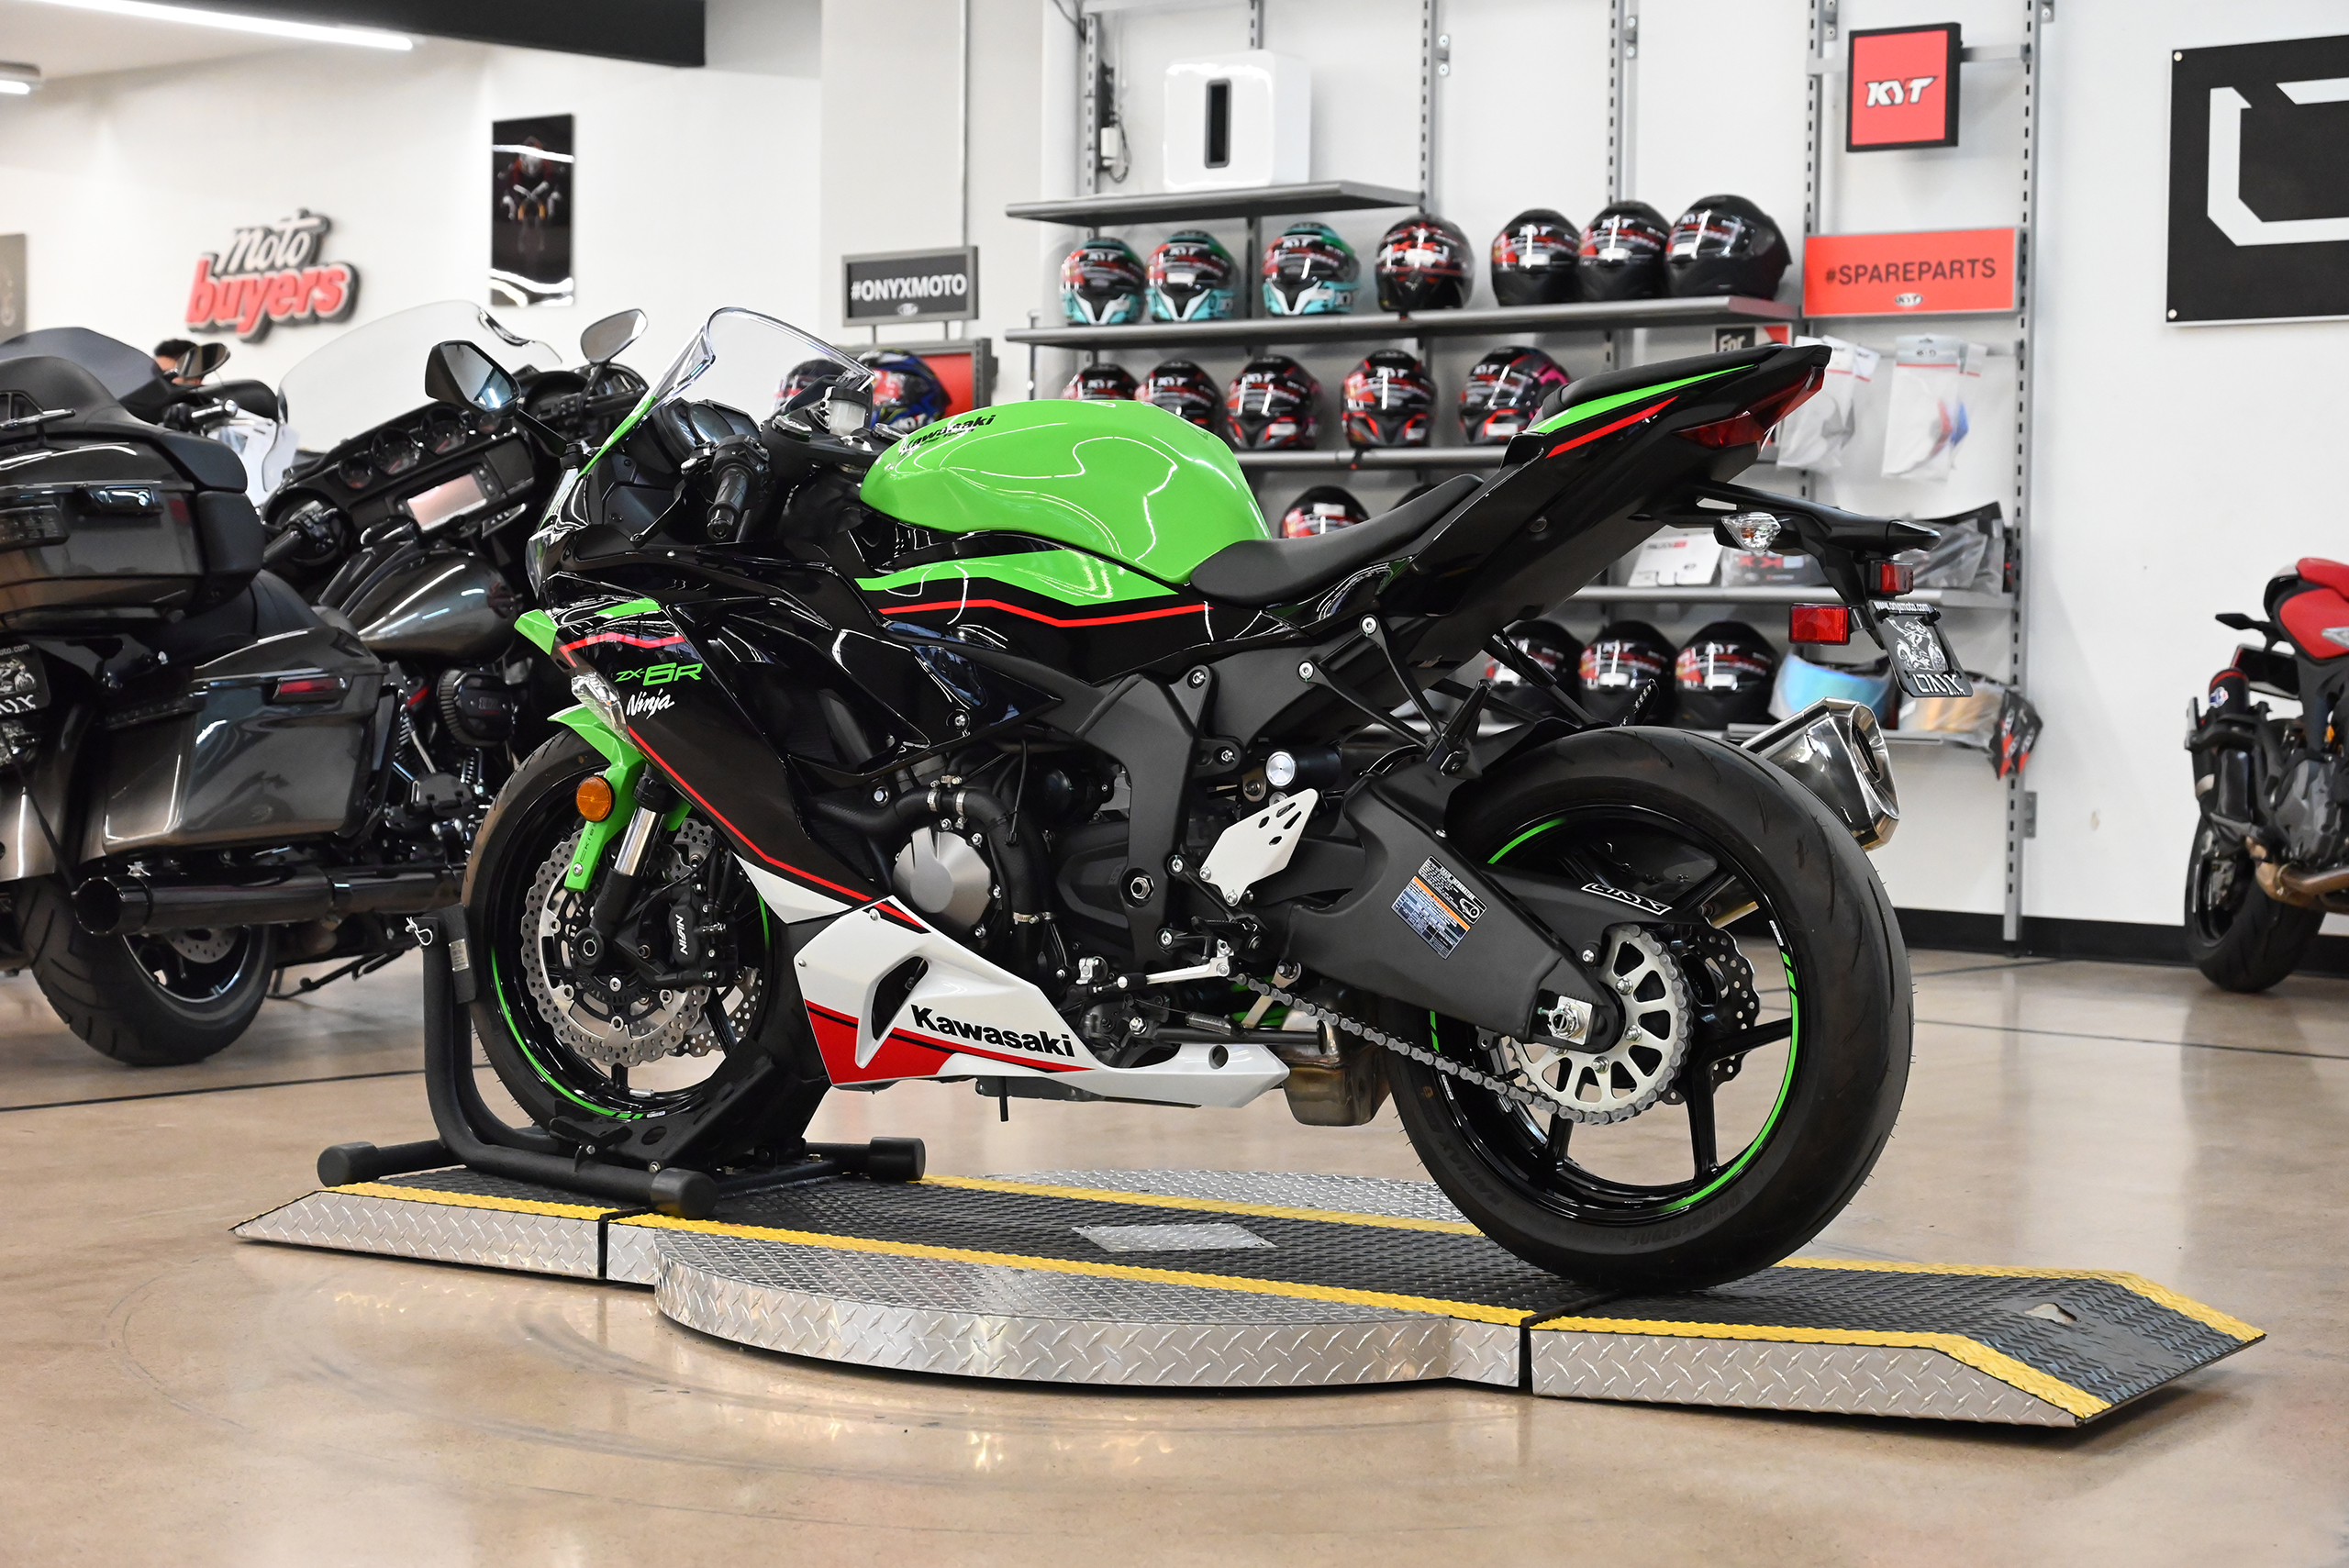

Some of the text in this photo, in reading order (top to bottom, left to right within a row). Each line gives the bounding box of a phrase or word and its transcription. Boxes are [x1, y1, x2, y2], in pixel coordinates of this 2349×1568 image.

[1865, 75, 1939, 107] KYT
[851, 273, 967, 302] #ONYXMOTO
[1825, 257, 1996, 286] #SPAREPARTS
[186, 255, 348, 334] buyers
[615, 662, 703, 686] ZX-6R
[626, 687, 675, 720] Ninja
[911, 1005, 1075, 1057] Kawasaki
